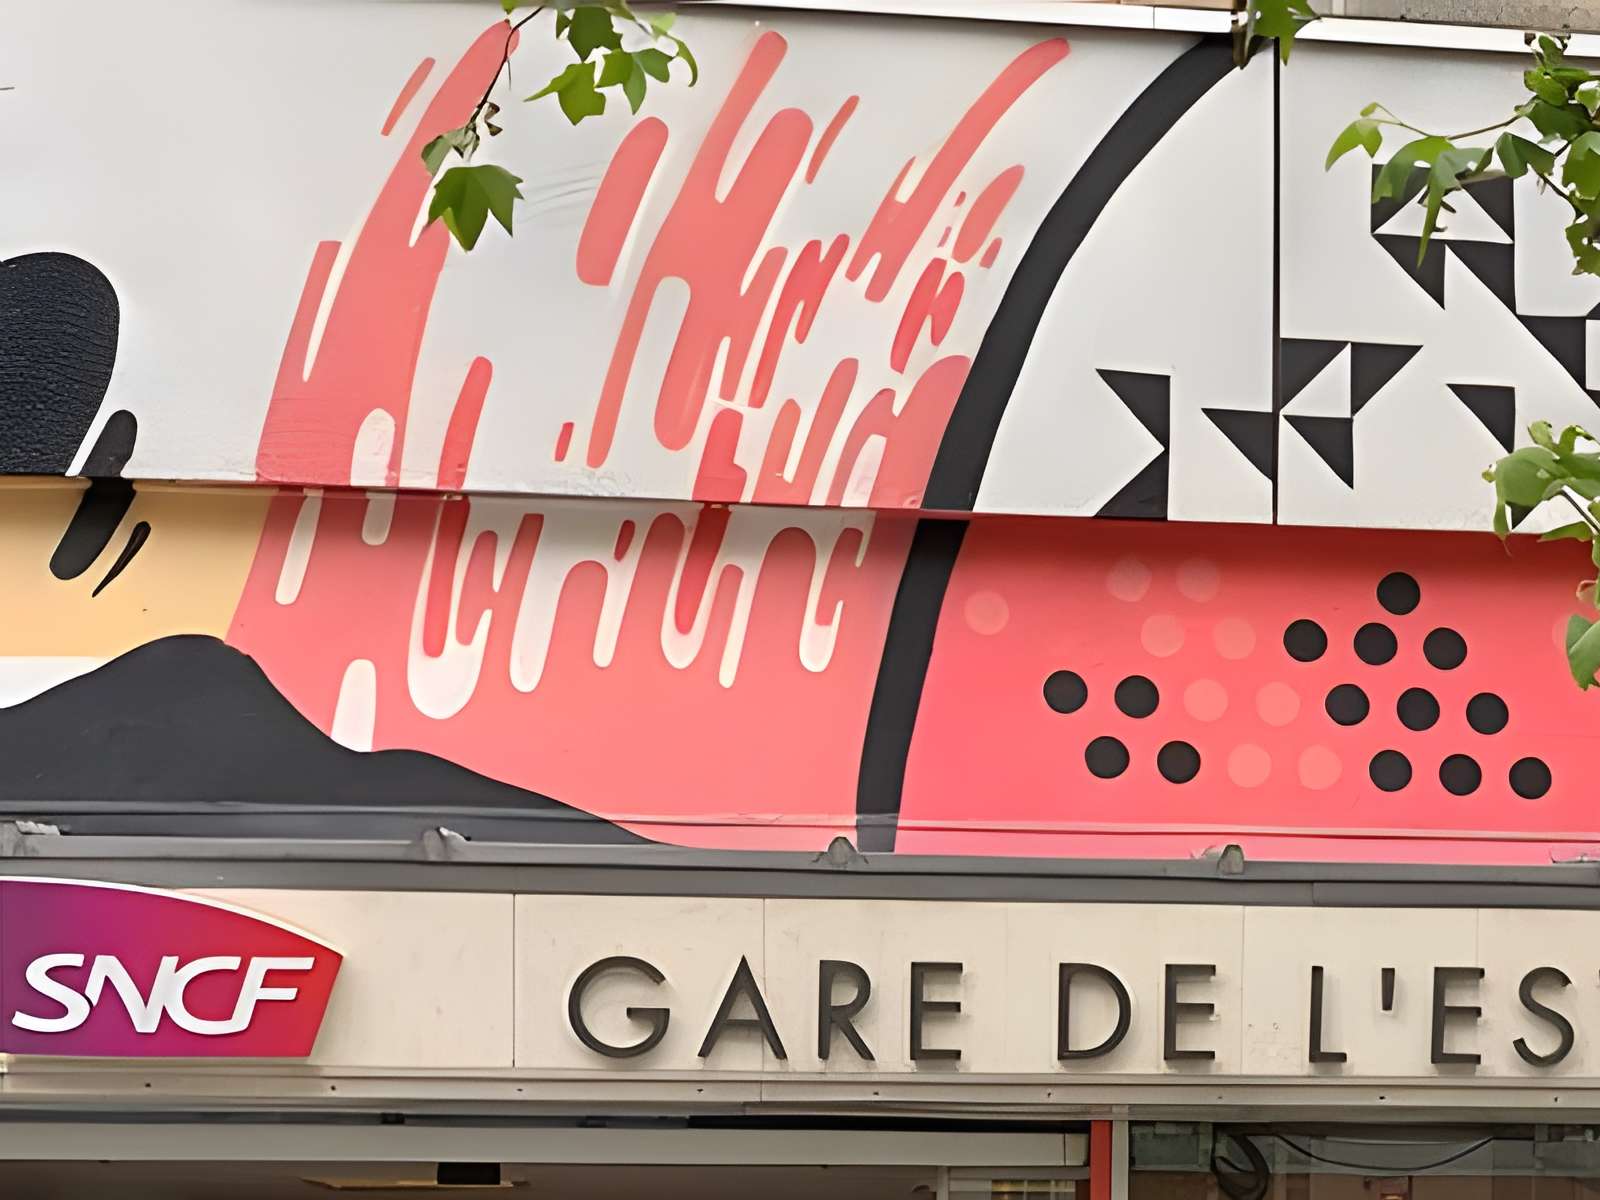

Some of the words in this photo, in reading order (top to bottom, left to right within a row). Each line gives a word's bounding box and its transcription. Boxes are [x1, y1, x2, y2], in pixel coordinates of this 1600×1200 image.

[12, 953, 315, 1035] SNCF
[567, 954, 964, 1060] GARE
[1057, 961, 1215, 1061] DE
